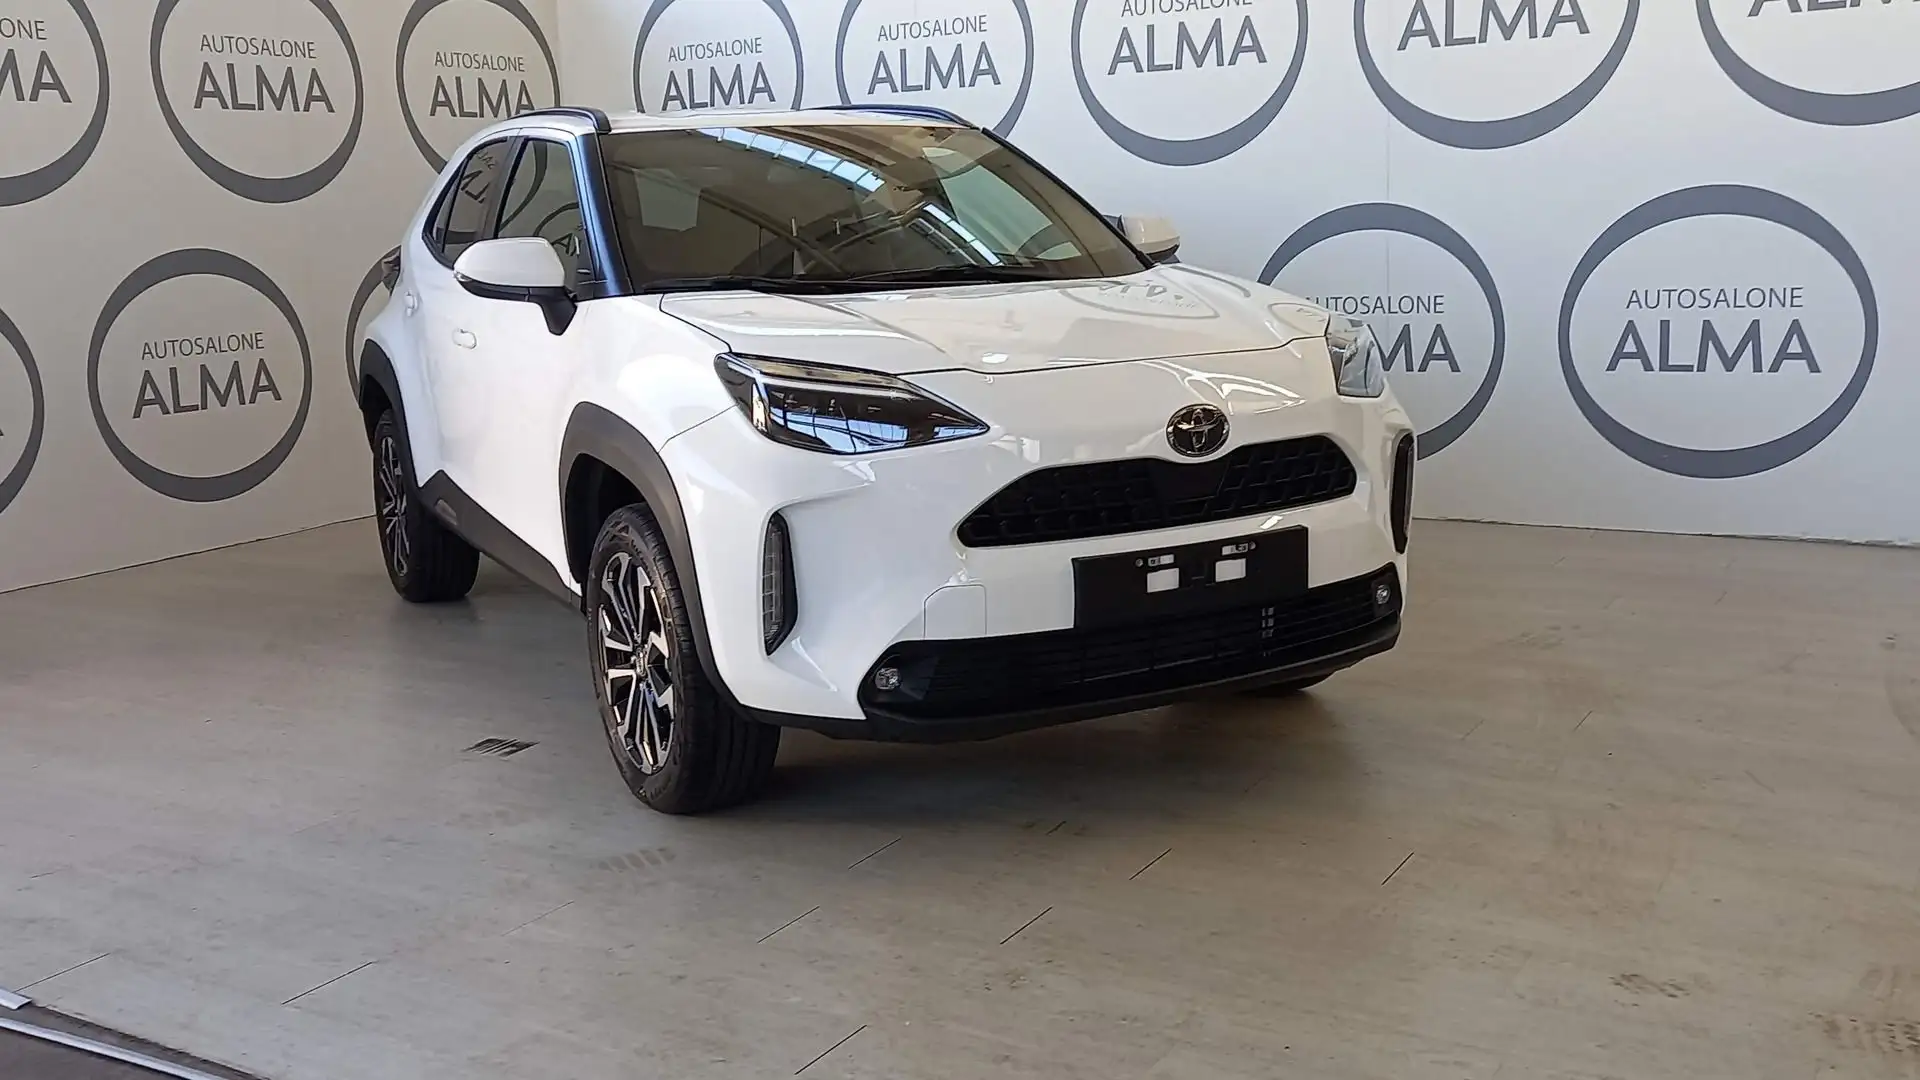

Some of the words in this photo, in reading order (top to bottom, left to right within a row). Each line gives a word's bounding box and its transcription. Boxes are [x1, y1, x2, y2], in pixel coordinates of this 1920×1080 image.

[877, 14, 987, 42] AUTOSALONE
[1121, 0, 1252, 17] AUTOSA
[1397, 0, 1590, 51] ALMA
[200, 34, 317, 59] AUTOSALONE
[435, 51, 525, 72] AUTOSALONE
[668, 37, 762, 62] AUTOSALONE
[1107, 15, 1267, 75] ALMA
[194, 61, 335, 113] ALMA
[661, 61, 776, 111] ALMA
[867, 41, 1001, 95] ALMA
[430, 75, 535, 118] ALMA
[1305, 295, 1445, 315] TOSALONE
[1625, 287, 1804, 309] AUTOSALONE
[141, 332, 265, 360] AUTOSALONE
[1366, 323, 1461, 372] MA
[1605, 319, 1822, 373] ALMA
[132, 358, 282, 419] ALMA
